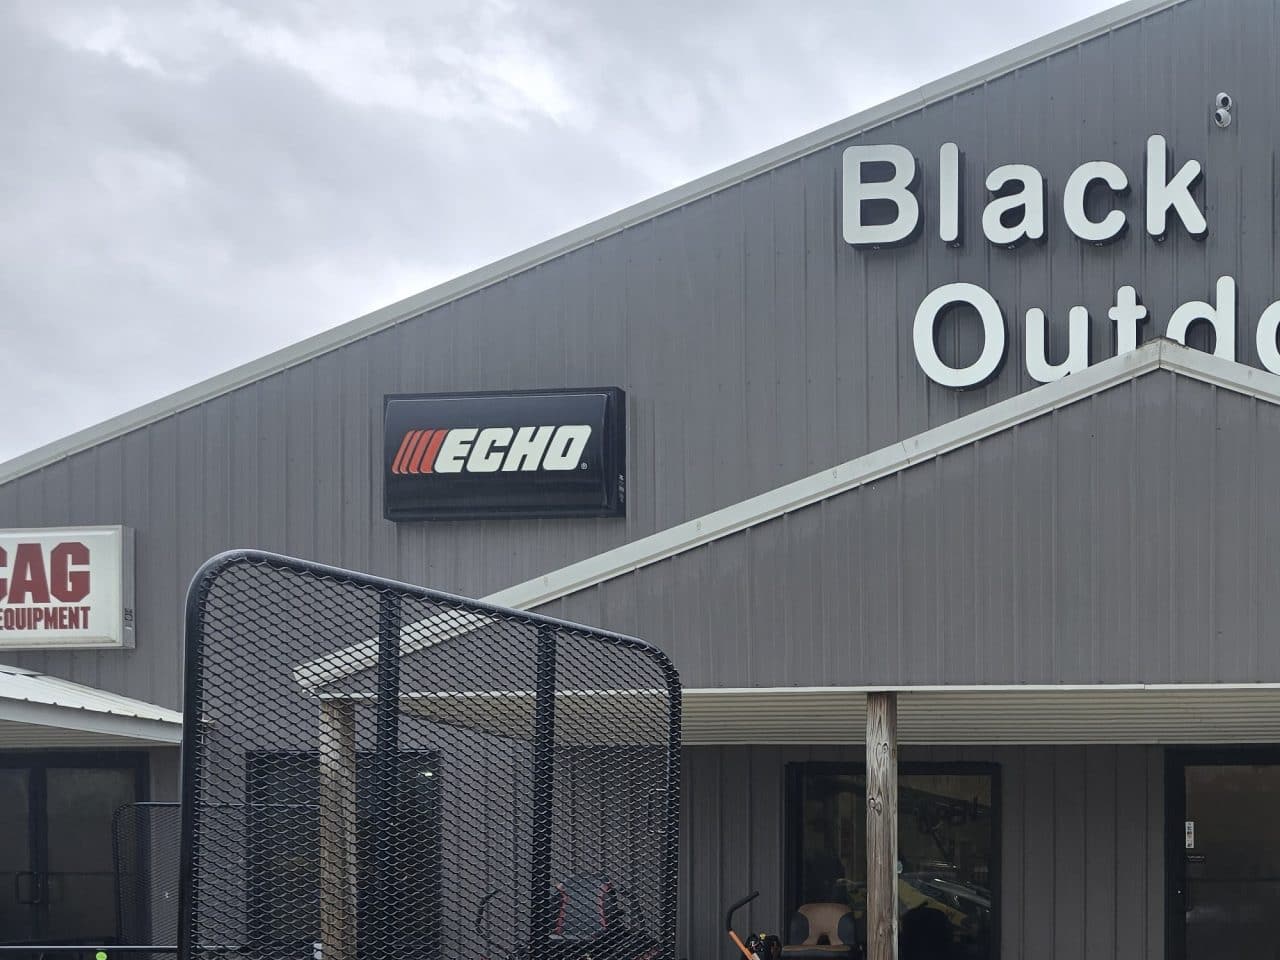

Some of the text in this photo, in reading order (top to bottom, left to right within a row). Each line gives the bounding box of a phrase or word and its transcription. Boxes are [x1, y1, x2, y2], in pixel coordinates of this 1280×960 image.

[842, 134, 1208, 244] Black
[434, 424, 592, 474] ECHO
[0, 541, 91, 604] AG
